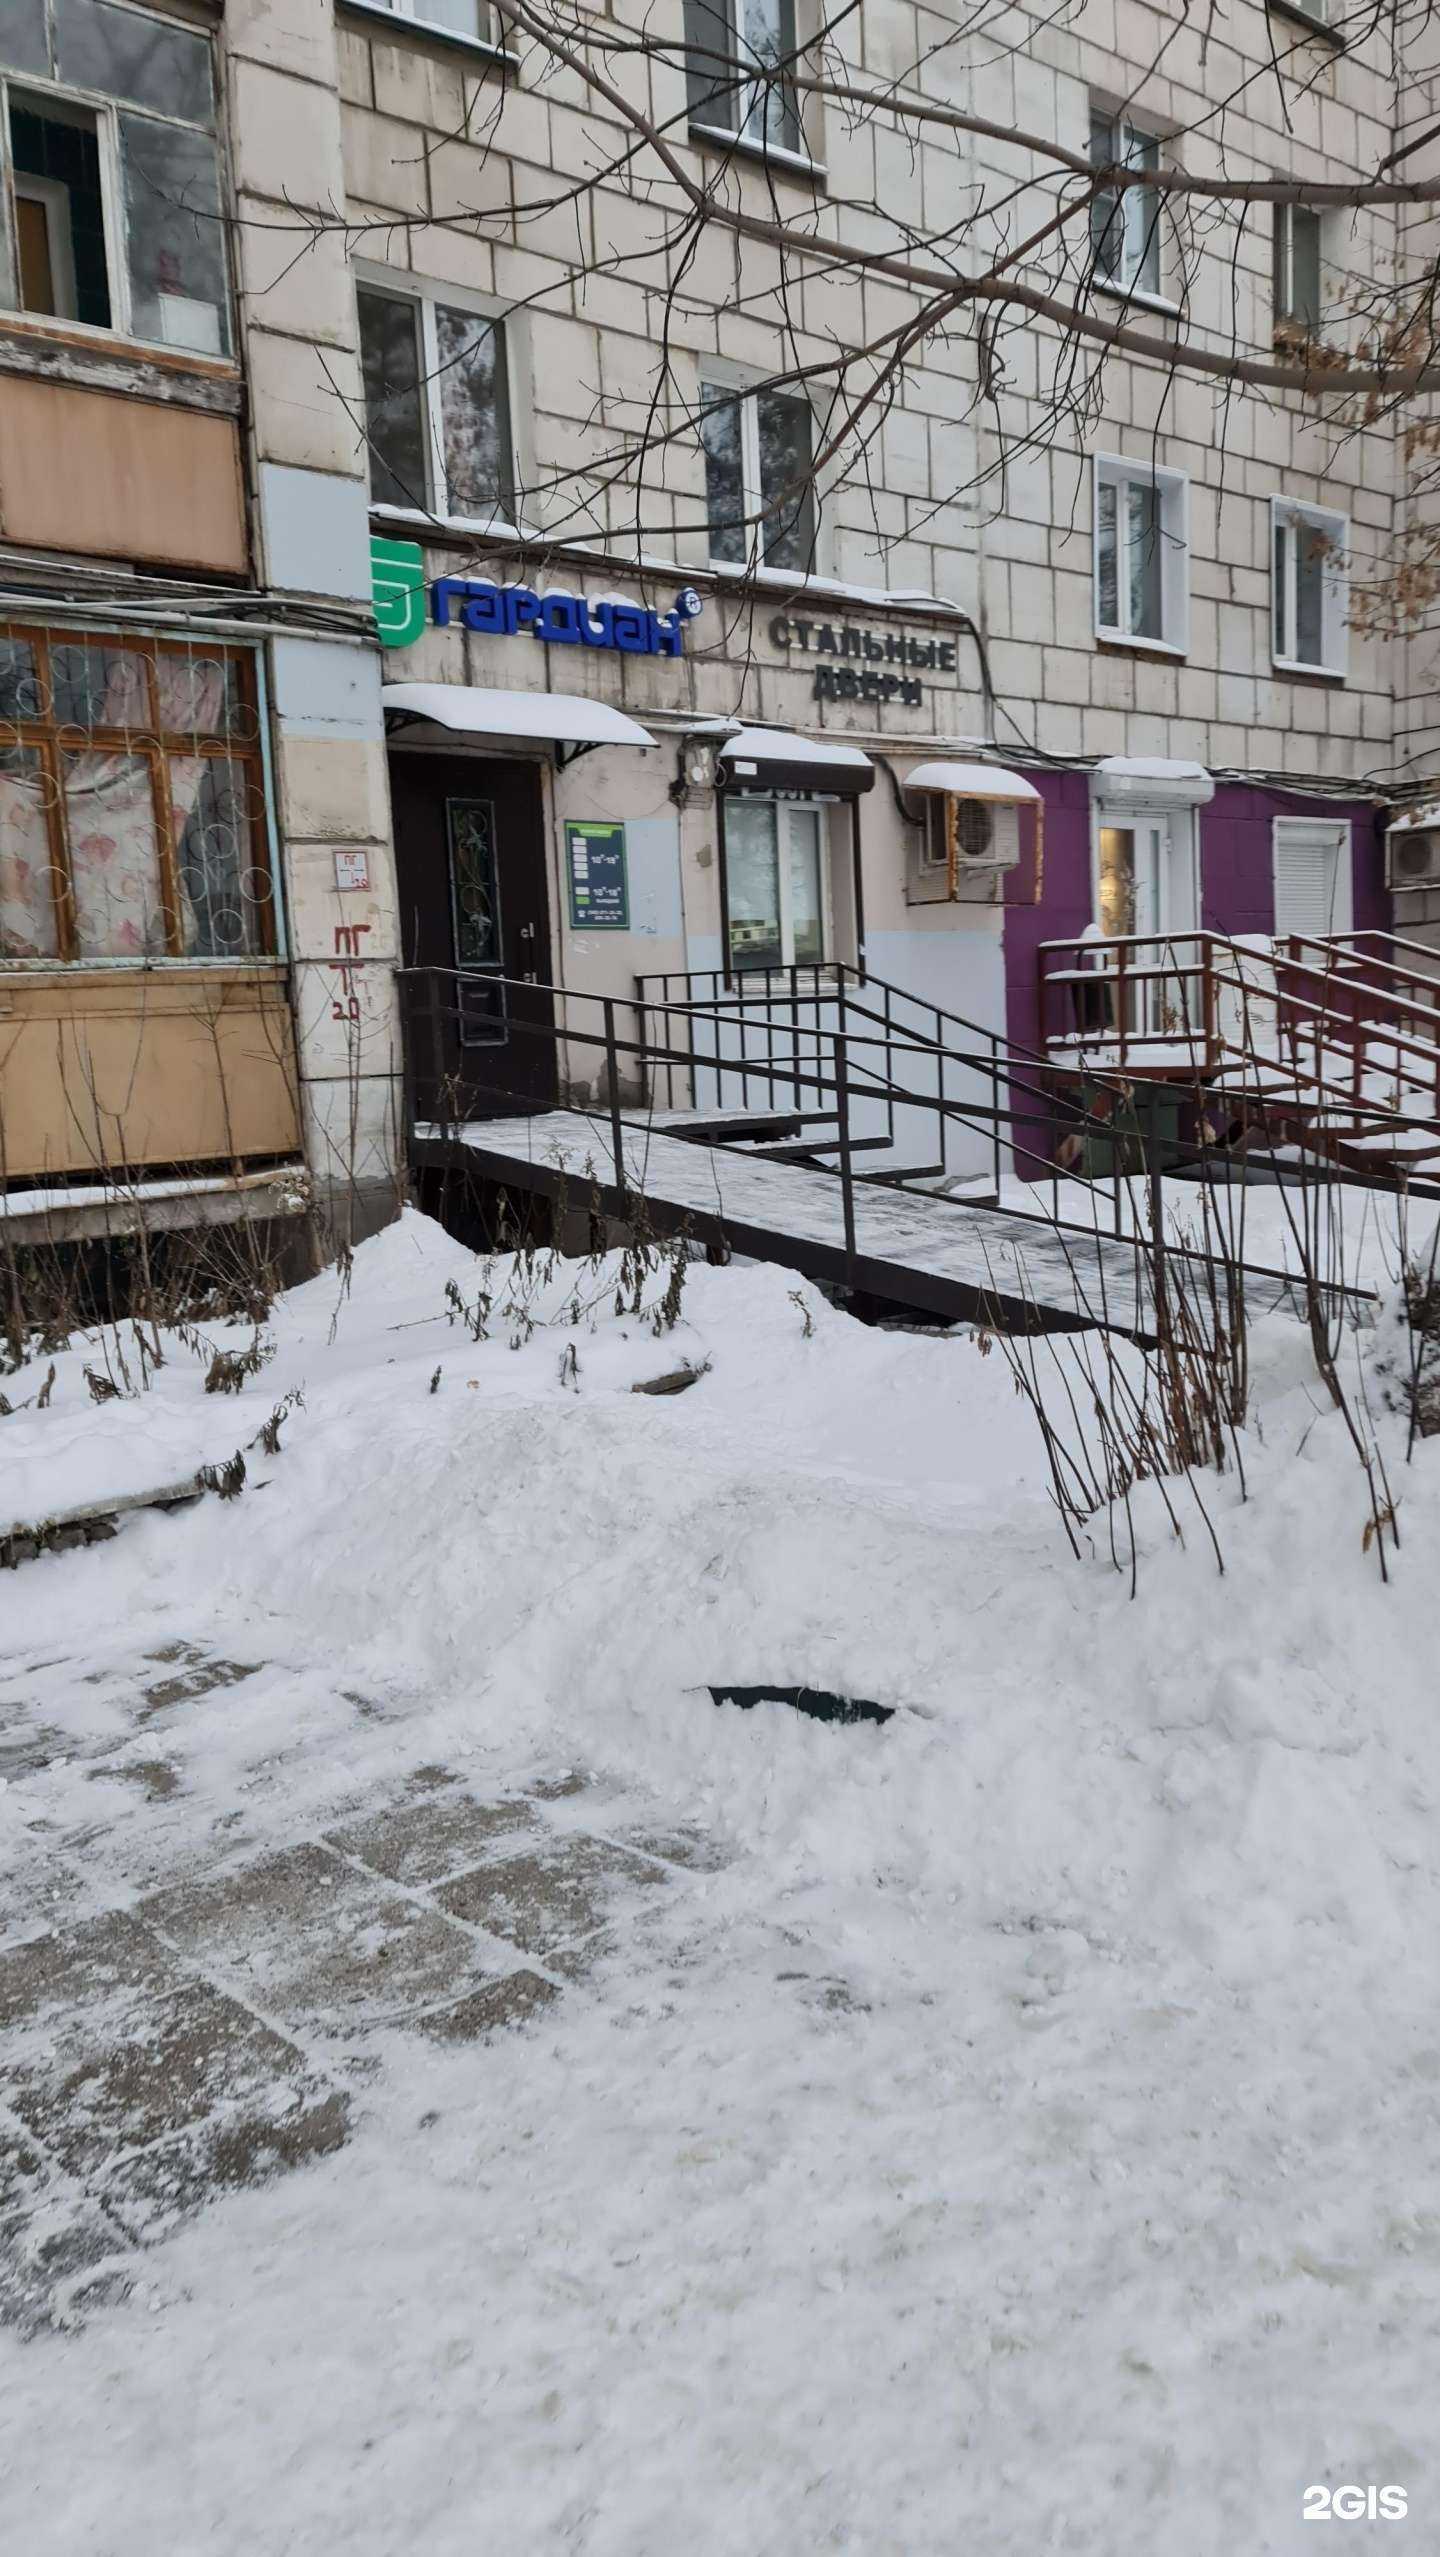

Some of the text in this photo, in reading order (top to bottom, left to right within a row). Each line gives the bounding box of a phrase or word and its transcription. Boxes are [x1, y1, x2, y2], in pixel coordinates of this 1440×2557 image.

[770, 616, 956, 672] СТАЛЬНЫЕ
[814, 664, 922, 706] ДВЕРИ
[334, 924, 371, 957] ПГ
[332, 997, 361, 1021] 20
